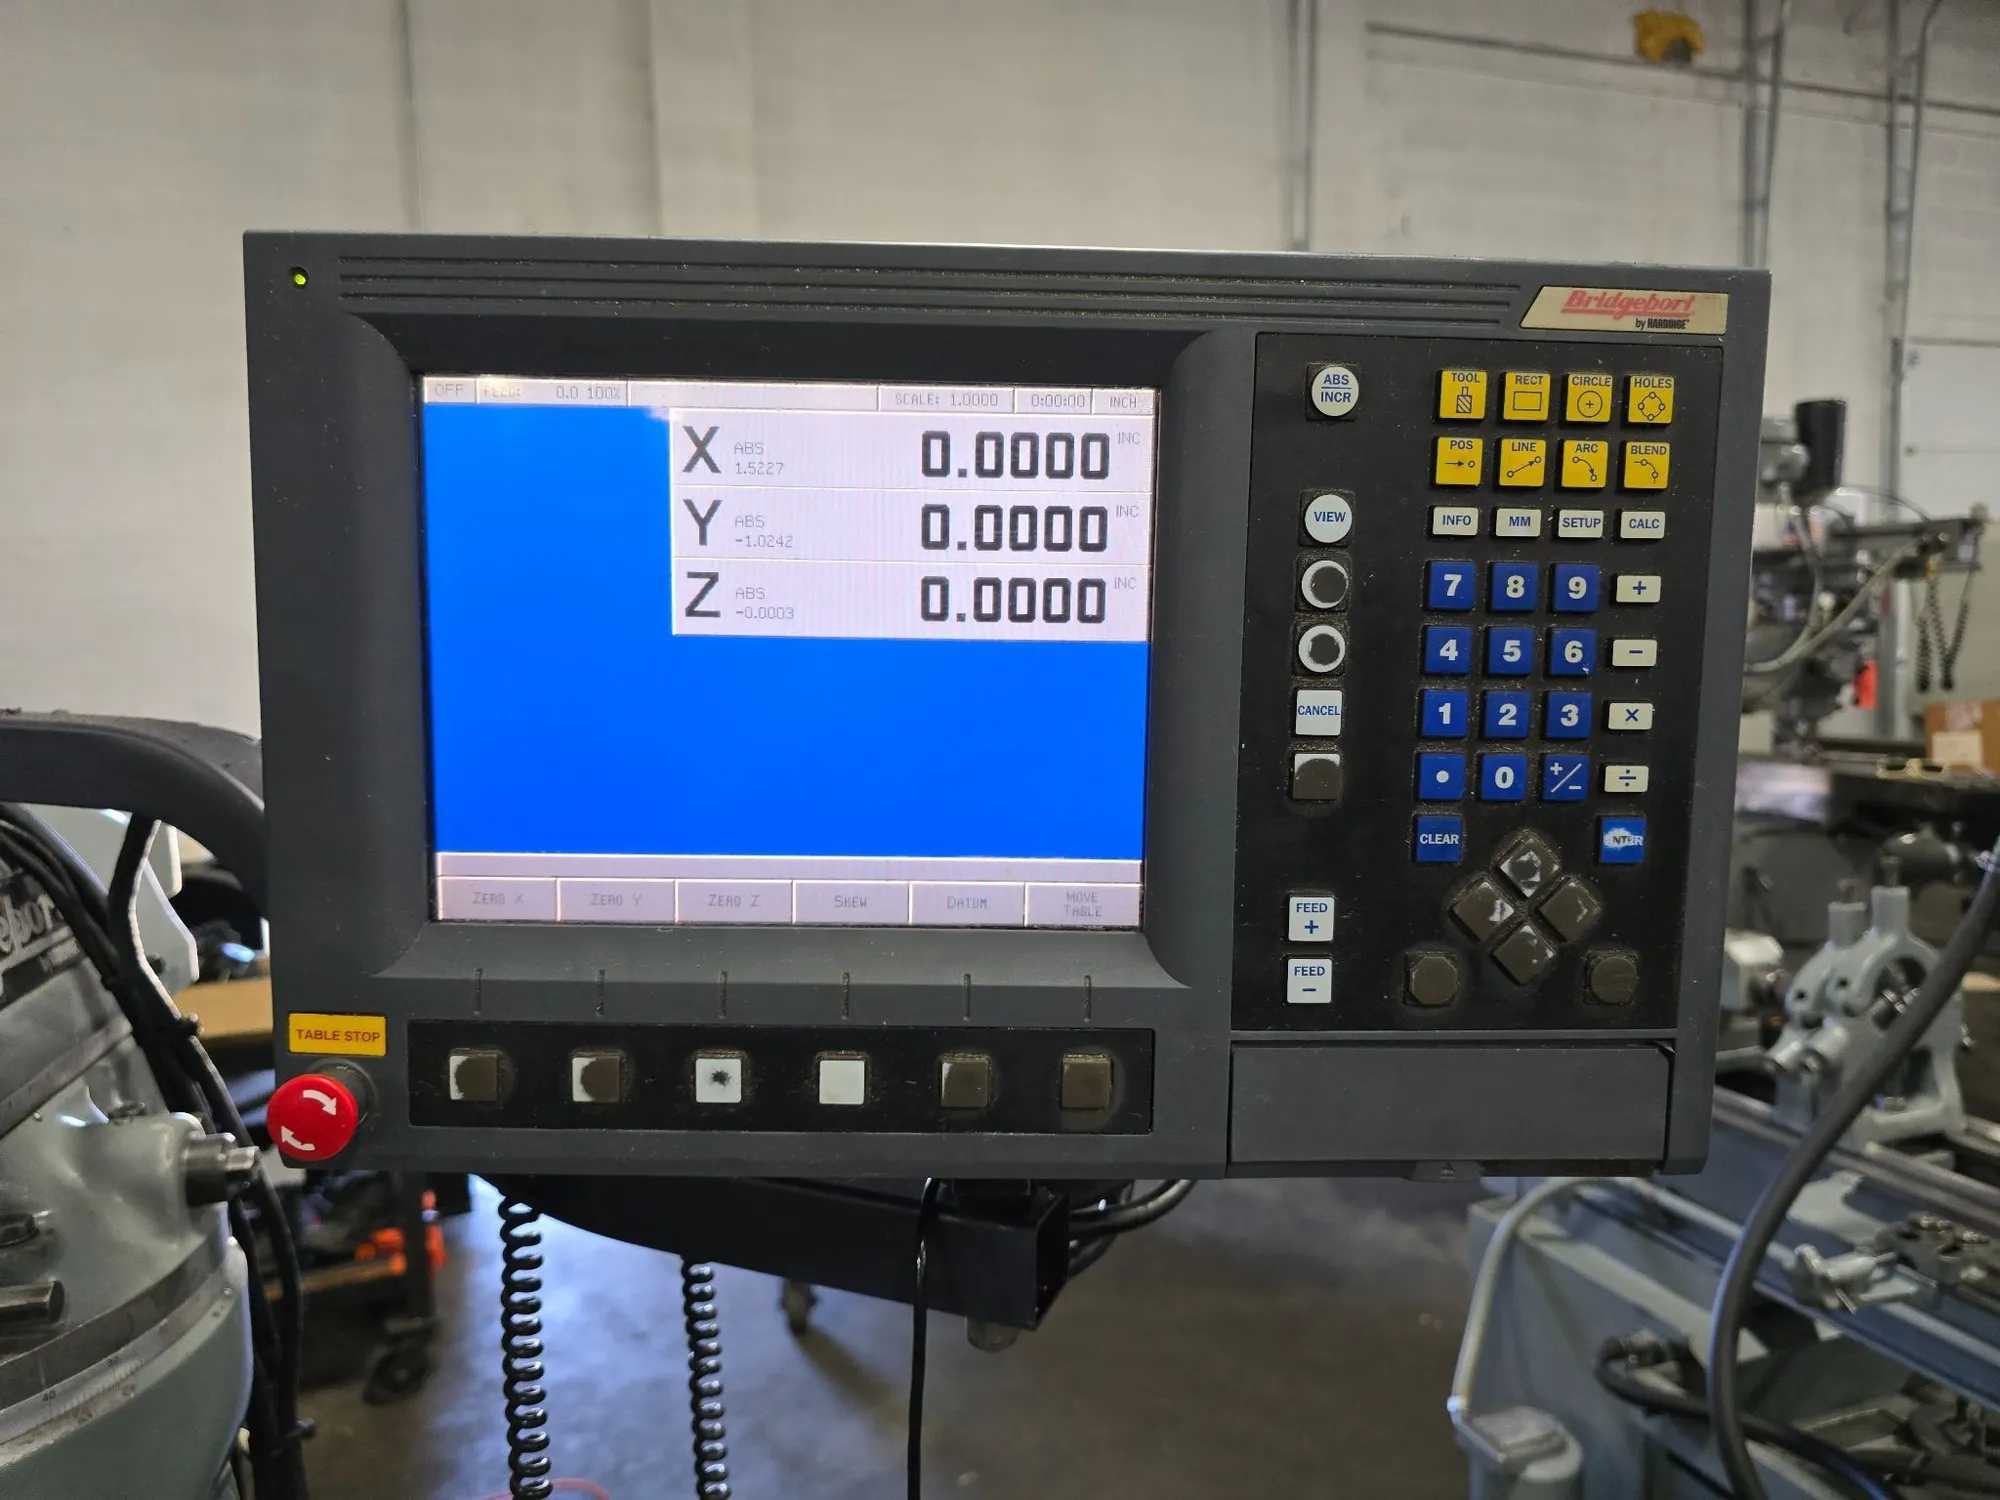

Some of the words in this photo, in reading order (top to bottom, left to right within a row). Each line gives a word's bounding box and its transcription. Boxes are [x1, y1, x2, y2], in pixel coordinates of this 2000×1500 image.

[1564, 290, 1695, 320] Bridgeport
[1635, 318, 1646, 330] by
[1323, 374, 1349, 385] ABS
[1450, 372, 1481, 383] TOOL
[1514, 375, 1543, 385] RECT
[1571, 376, 1612, 387] CIRCLE
[1634, 377, 1672, 388] HOLES
[895, 393, 940, 408] SCALE:
[951, 393, 999, 408] 1.0000
[1031, 393, 1086, 408] 0:00:00
[1109, 395, 1138, 409] INCH
[1320, 391, 1352, 403] INCR
[1117, 431, 1141, 446] INC
[1449, 440, 1473, 450] POS
[682, 425, 722, 474] X
[734, 442, 765, 456] ABS
[1511, 442, 1537, 452] LINE
[1575, 443, 1599, 453] ARC
[1630, 445, 1667, 455] BLEND
[921, 430, 1110, 480] 0.0000
[735, 462, 784, 476] 1.5227
[1115, 505, 1140, 518] INC
[1313, 511, 1347, 523] VIEW
[682, 499, 722, 546] Y
[734, 515, 766, 528] ABS
[1441, 515, 1472, 526] INFO
[1508, 516, 1531, 527] MM
[1562, 517, 1601, 529] SETUP
[1628, 518, 1660, 529] CALC
[921, 504, 1108, 552] 0.0000
[735, 535, 794, 549] -1.0242
[1113, 577, 1138, 590] INC
[1443, 573, 1462, 597] 7
[1505, 575, 1525, 598] 8
[1567, 576, 1587, 600] 9
[684, 571, 721, 618] Z
[735, 587, 766, 600] ABS
[921, 575, 1106, 624] 0.0000
[735, 606, 795, 620] -0.0003
[1439, 639, 1459, 661] 4
[1502, 639, 1521, 662] 5
[1564, 640, 1583, 663] 6
[1297, 705, 1341, 716] CANCEL
[1438, 702, 1452, 725] 1
[1498, 703, 1517, 726] 2
[1560, 704, 1579, 727] 3
[1494, 766, 1514, 789] 0
[1420, 833, 1460, 845] CLEAR
[472, 891, 505, 906] ZERO
[590, 892, 623, 906] ZERO
[634, 893, 643, 906] Y
[708, 894, 742, 907] ZERO
[751, 895, 761, 908] Z
[834, 895, 868, 909] SKEW
[947, 895, 988, 910] DATUM
[1066, 890, 1099, 903] MOVE
[1064, 903, 1103, 917] TABLE
[1296, 902, 1328, 913] FEED
[1294, 966, 1326, 976] FEED
[295, 1028, 341, 1041] TABLE
[344, 1030, 381, 1043] STOP
